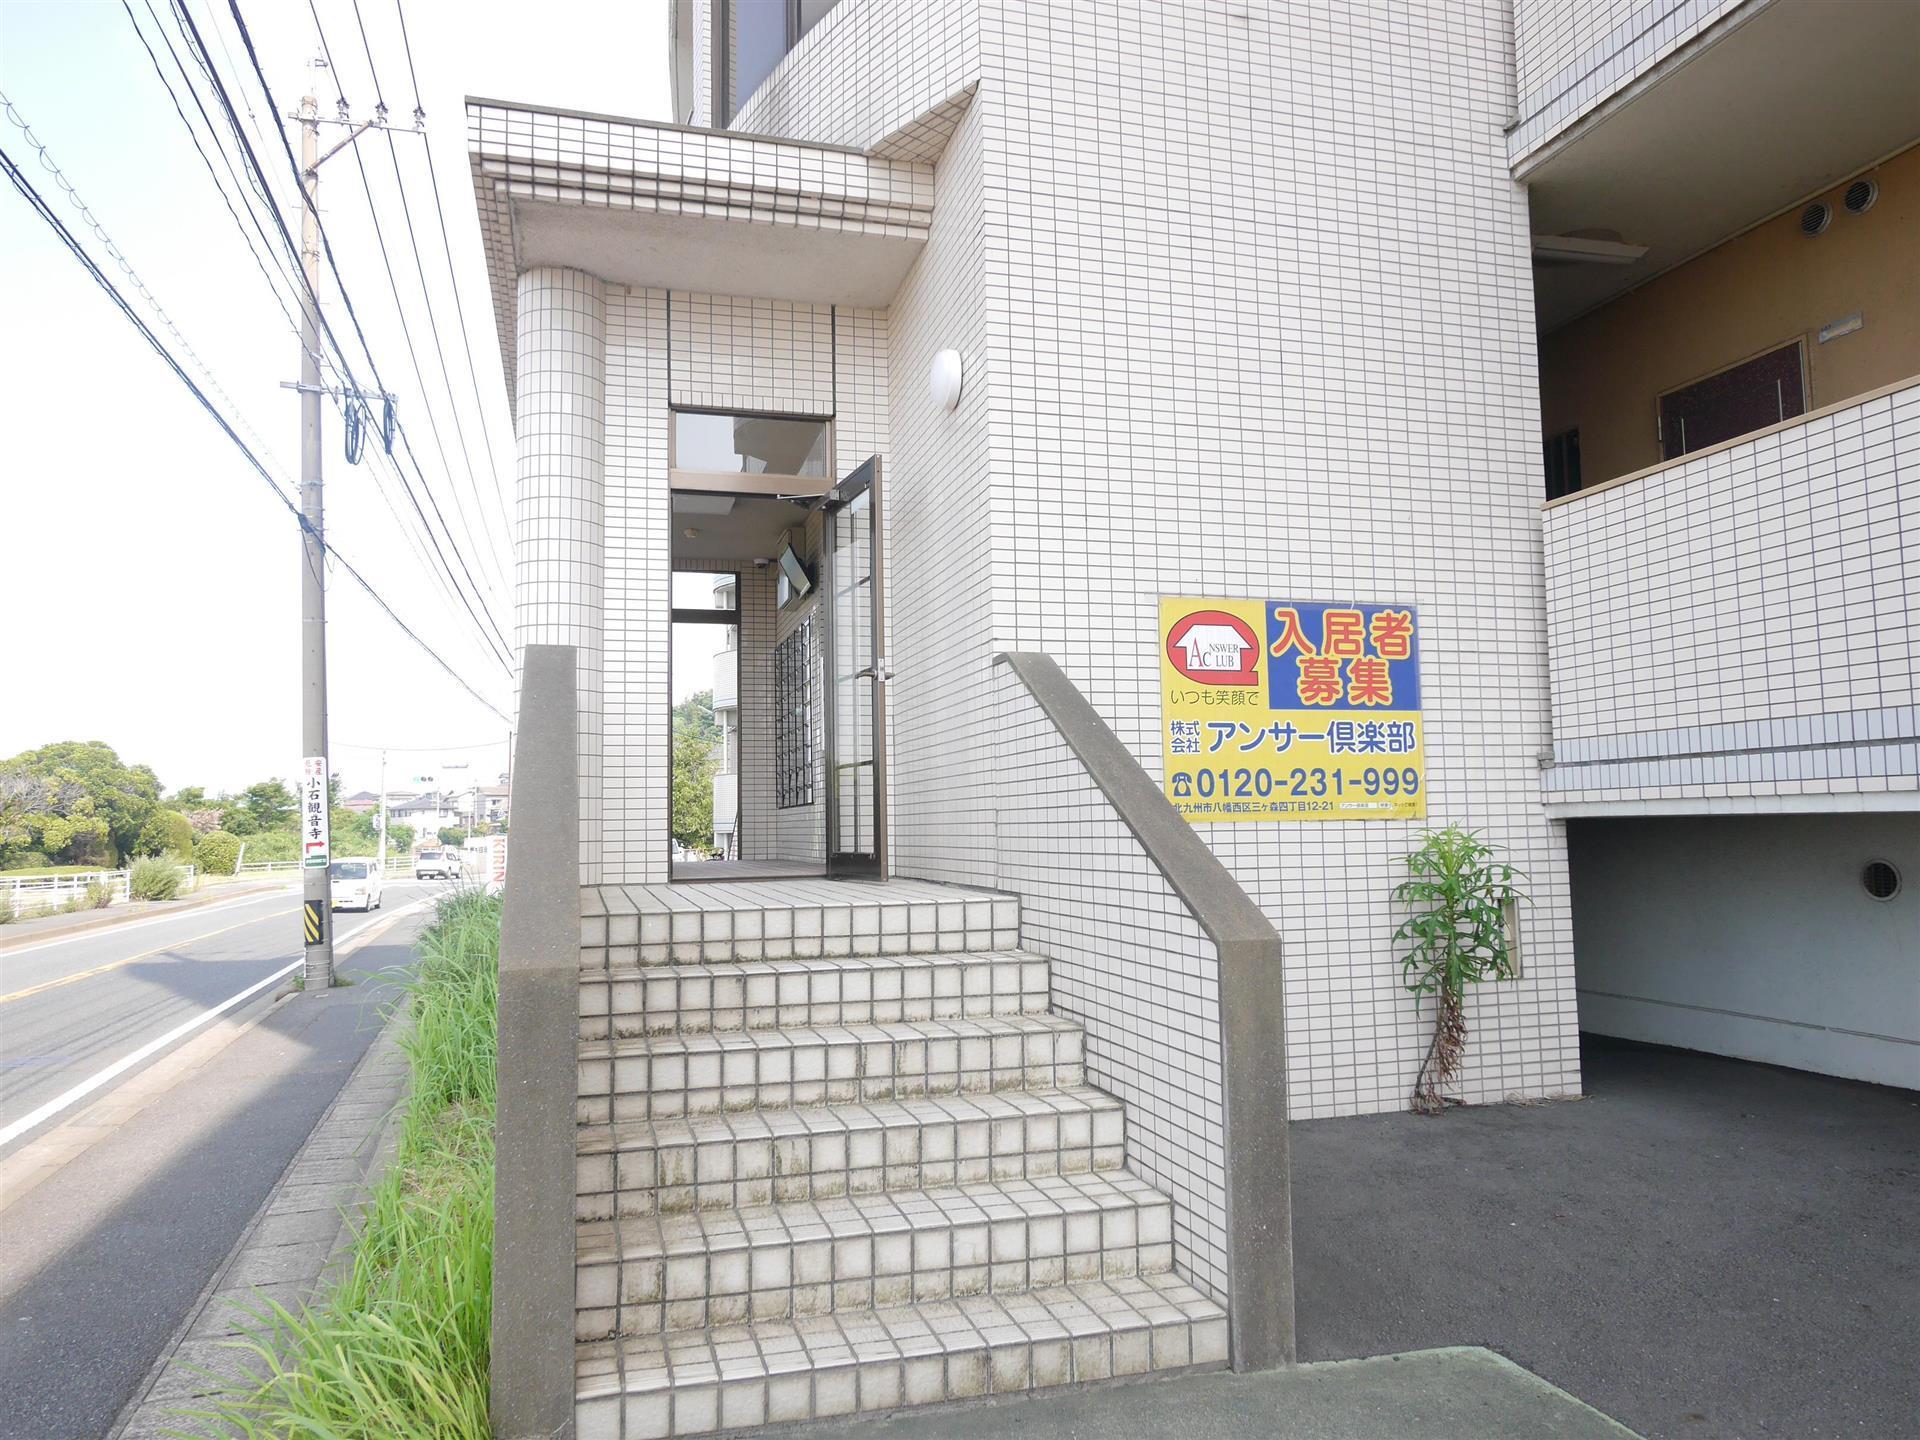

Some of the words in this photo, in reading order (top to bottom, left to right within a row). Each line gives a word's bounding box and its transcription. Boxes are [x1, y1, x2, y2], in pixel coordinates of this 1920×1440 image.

[1271, 608, 1415, 659] 入居者
[1170, 689, 1260, 706] いつも笑顔で
[1298, 657, 1393, 705] 募集
[1207, 720, 1416, 754] アンサー倶楽部
[1197, 767, 1419, 797] 0120-231-999
[307, 777, 322, 840] 小石観音寺
[493, 839, 506, 882] KIRIN
